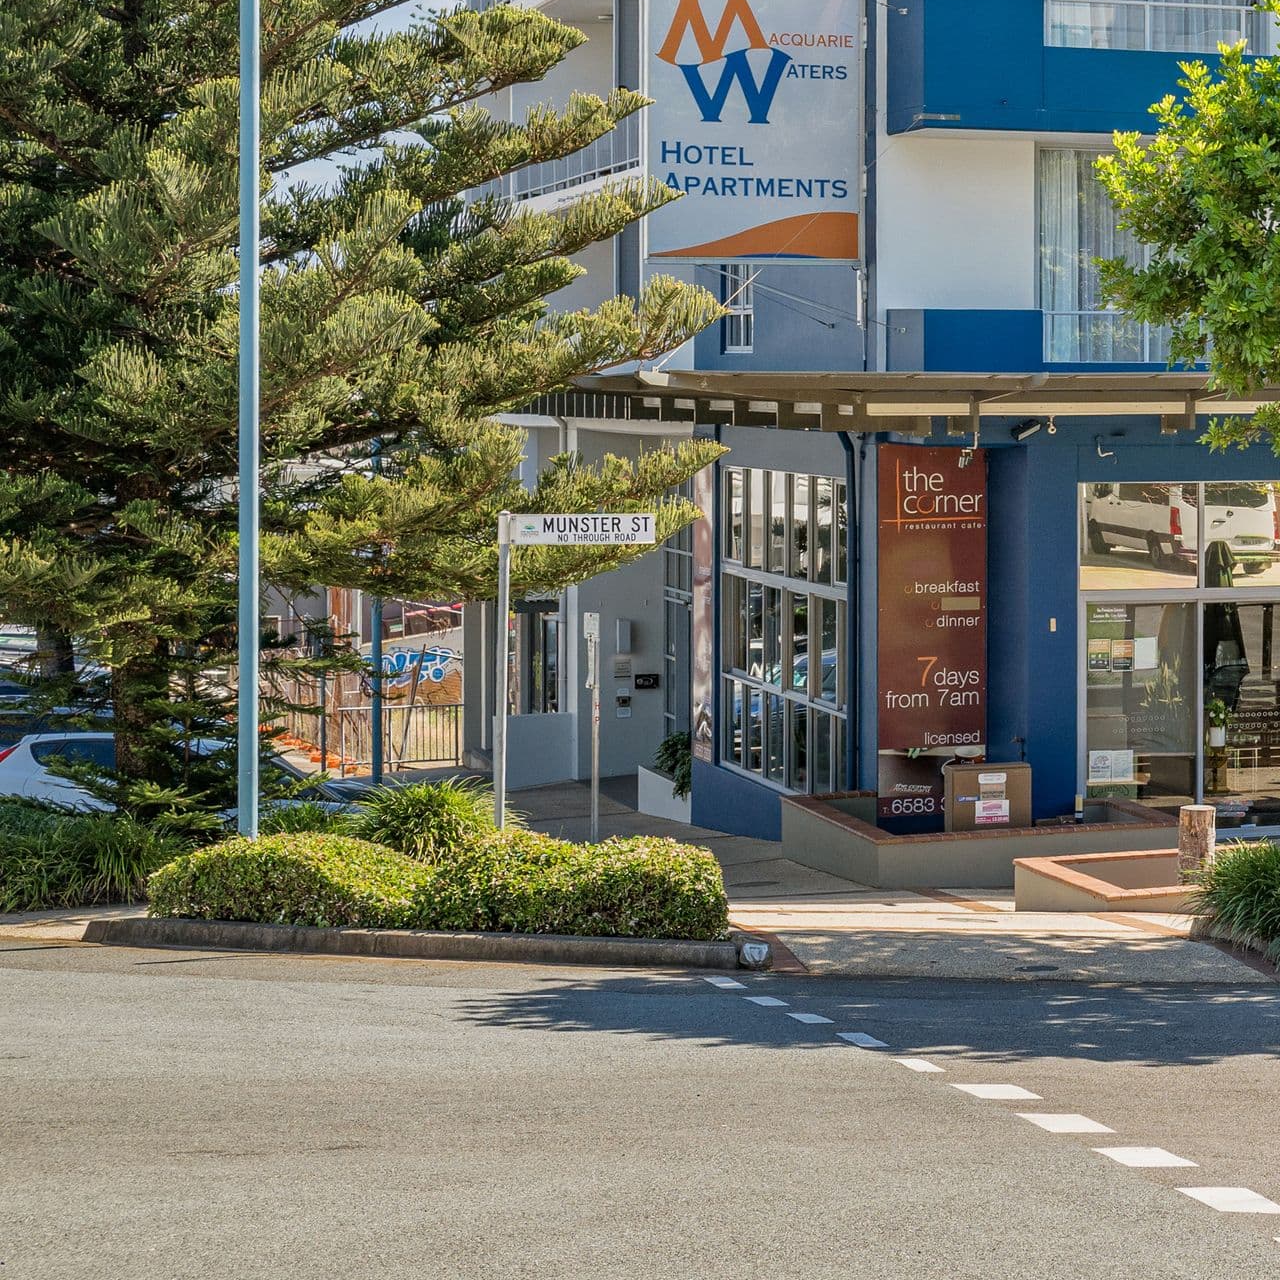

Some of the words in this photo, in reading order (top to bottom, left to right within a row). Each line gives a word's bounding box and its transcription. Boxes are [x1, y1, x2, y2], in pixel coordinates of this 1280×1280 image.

[661, 140, 754, 167] HOTEL
[665, 172, 848, 199] APARTMENTS
[902, 466, 944, 492] the
[903, 494, 983, 515] corner
[543, 516, 621, 534] MUNSTER
[631, 516, 650, 533] ST
[557, 534, 569, 543] NO
[573, 534, 610, 542] THROUGH
[614, 532, 637, 542] ROAD
[915, 580, 980, 594] breakfast
[936, 615, 980, 628] dinner
[917, 656, 938, 687] 7
[934, 667, 980, 689] days
[885, 691, 929, 709] from
[937, 689, 980, 707] 7am
[924, 730, 981, 745] licensed
[892, 797, 935, 814] 6583
